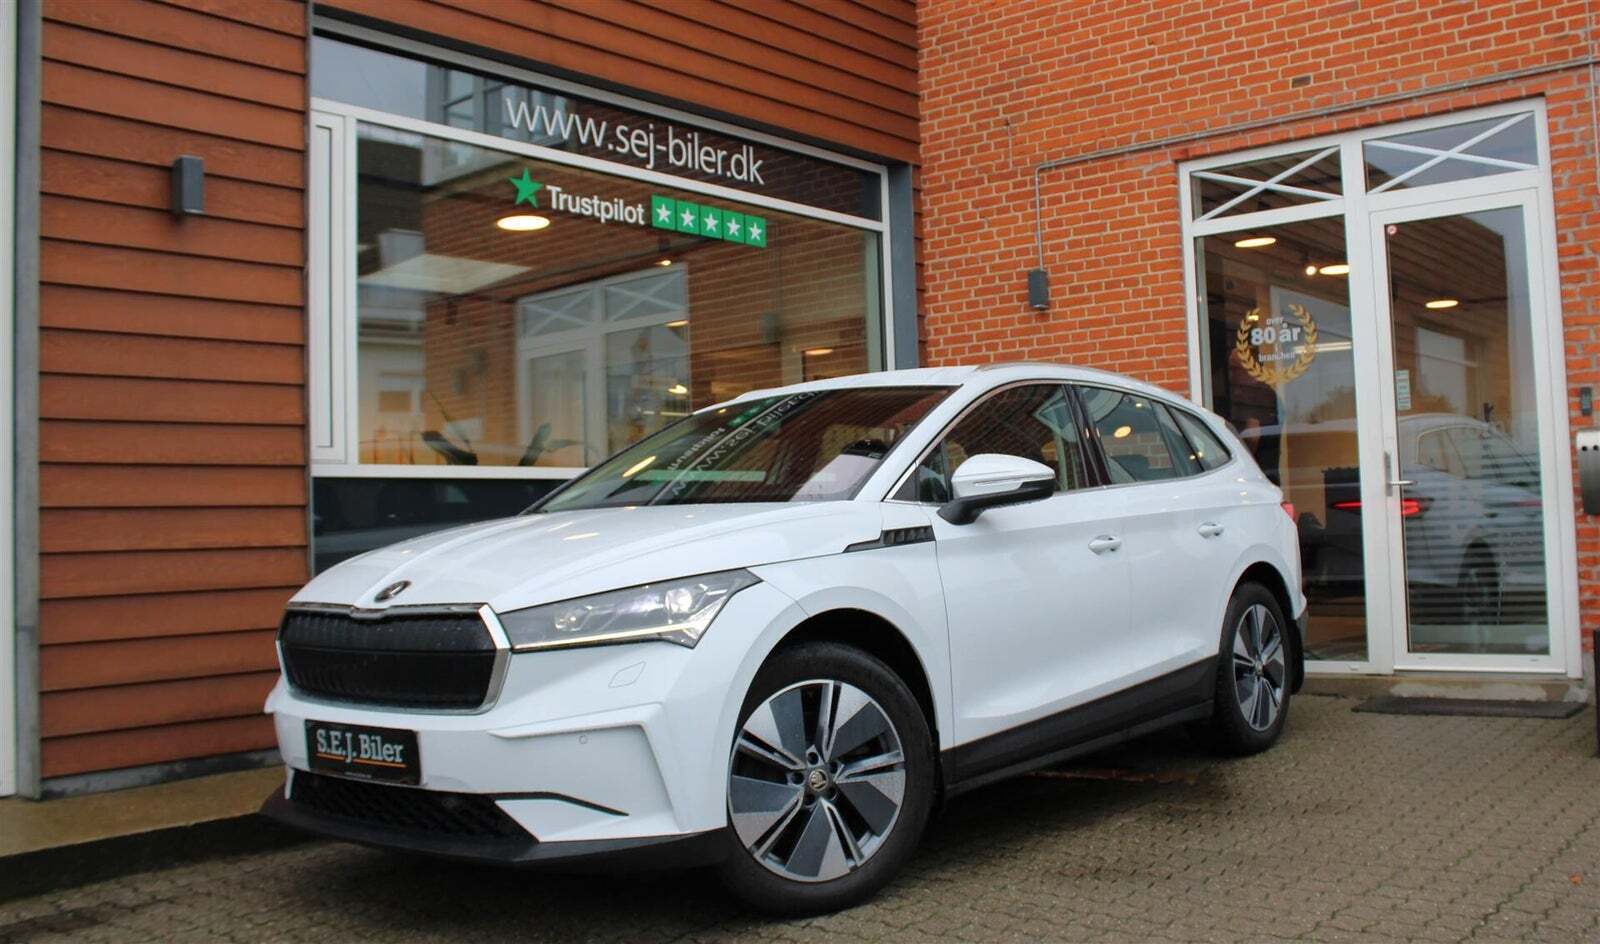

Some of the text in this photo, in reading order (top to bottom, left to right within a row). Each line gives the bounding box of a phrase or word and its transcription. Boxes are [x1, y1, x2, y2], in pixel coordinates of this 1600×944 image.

[506, 98, 765, 185] www.sej-biler.dk
[546, 184, 646, 226] Trustpilot
[1251, 322, 1300, 345] 80 år
[316, 729, 404, 763] S.E.J. Biler
